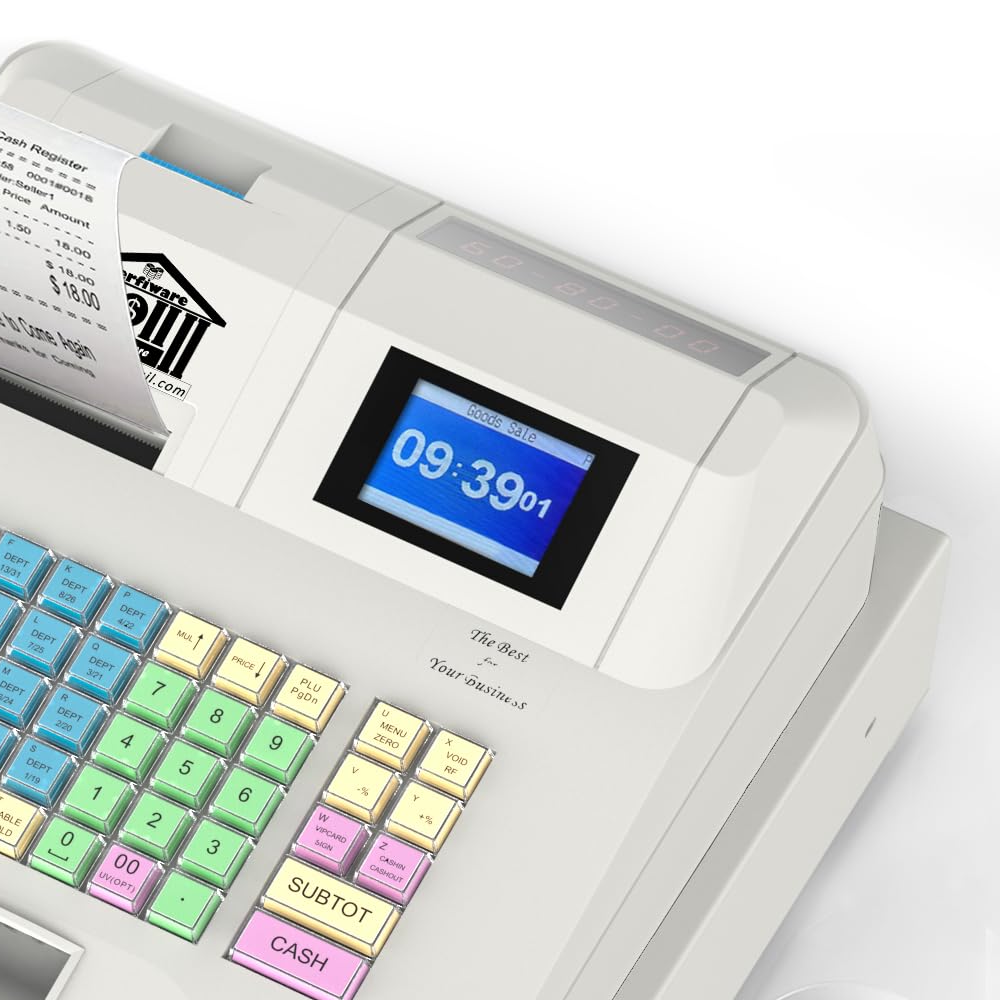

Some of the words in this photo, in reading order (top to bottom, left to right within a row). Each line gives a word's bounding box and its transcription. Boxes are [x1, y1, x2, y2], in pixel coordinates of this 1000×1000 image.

[30, 144, 88, 173] Register
[2, 188, 32, 205] Price
[40, 203, 91, 229] Amount
[6, 219, 32, 235] 1.50
[54, 239, 92, 260] 18.00
[122, 269, 188, 307] erfiware
[467, 404, 503, 428] Goods
[507, 422, 537, 443] Sale
[3, 552, 30, 568] DEPT
[61, 578, 88, 595] DEPT
[119, 604, 146, 620] DEPT
[31, 629, 57, 645] DEPT
[176, 630, 193, 643] MUL
[470, 629, 496, 648] The
[497, 642, 530, 663] Best
[89, 656, 115, 672] DEPT
[231, 655, 256, 671] PRICE
[430, 657, 464, 680] Your
[2, 667, 12, 676] M
[0, 680, 26, 696] DEPT
[151, 680, 166, 696] 7
[299, 677, 323, 694] PLU
[290, 687, 319, 705] PgDn
[57, 706, 84, 723] DEPT
[209, 708, 224, 724] 8
[381, 709, 390, 718] U
[380, 721, 408, 738] MENU
[120, 734, 134, 749] 4
[268, 735, 284, 751] 9
[373, 733, 400, 749] ZERO
[26, 757, 53, 774] DEPT
[446, 751, 468, 766] VOID
[178, 759, 194, 775] 5
[444, 765, 458, 776] RF
[92, 786, 102, 801] 1
[238, 787, 253, 803] 6
[146, 812, 162, 828] 2
[318, 812, 330, 823] W
[60, 831, 74, 847] 0
[315, 825, 347, 844] VIPCARD
[206, 839, 221, 855] 3
[314, 839, 334, 852] SIGN
[379, 842, 388, 851] Z
[113, 853, 140, 875] 00
[379, 854, 407, 871] CASHIN
[369, 864, 404, 884] CASHOUT
[99, 871, 136, 894] UV(OPT)
[287, 876, 373, 924] SUBTOT
[270, 935, 329, 973] CASH
